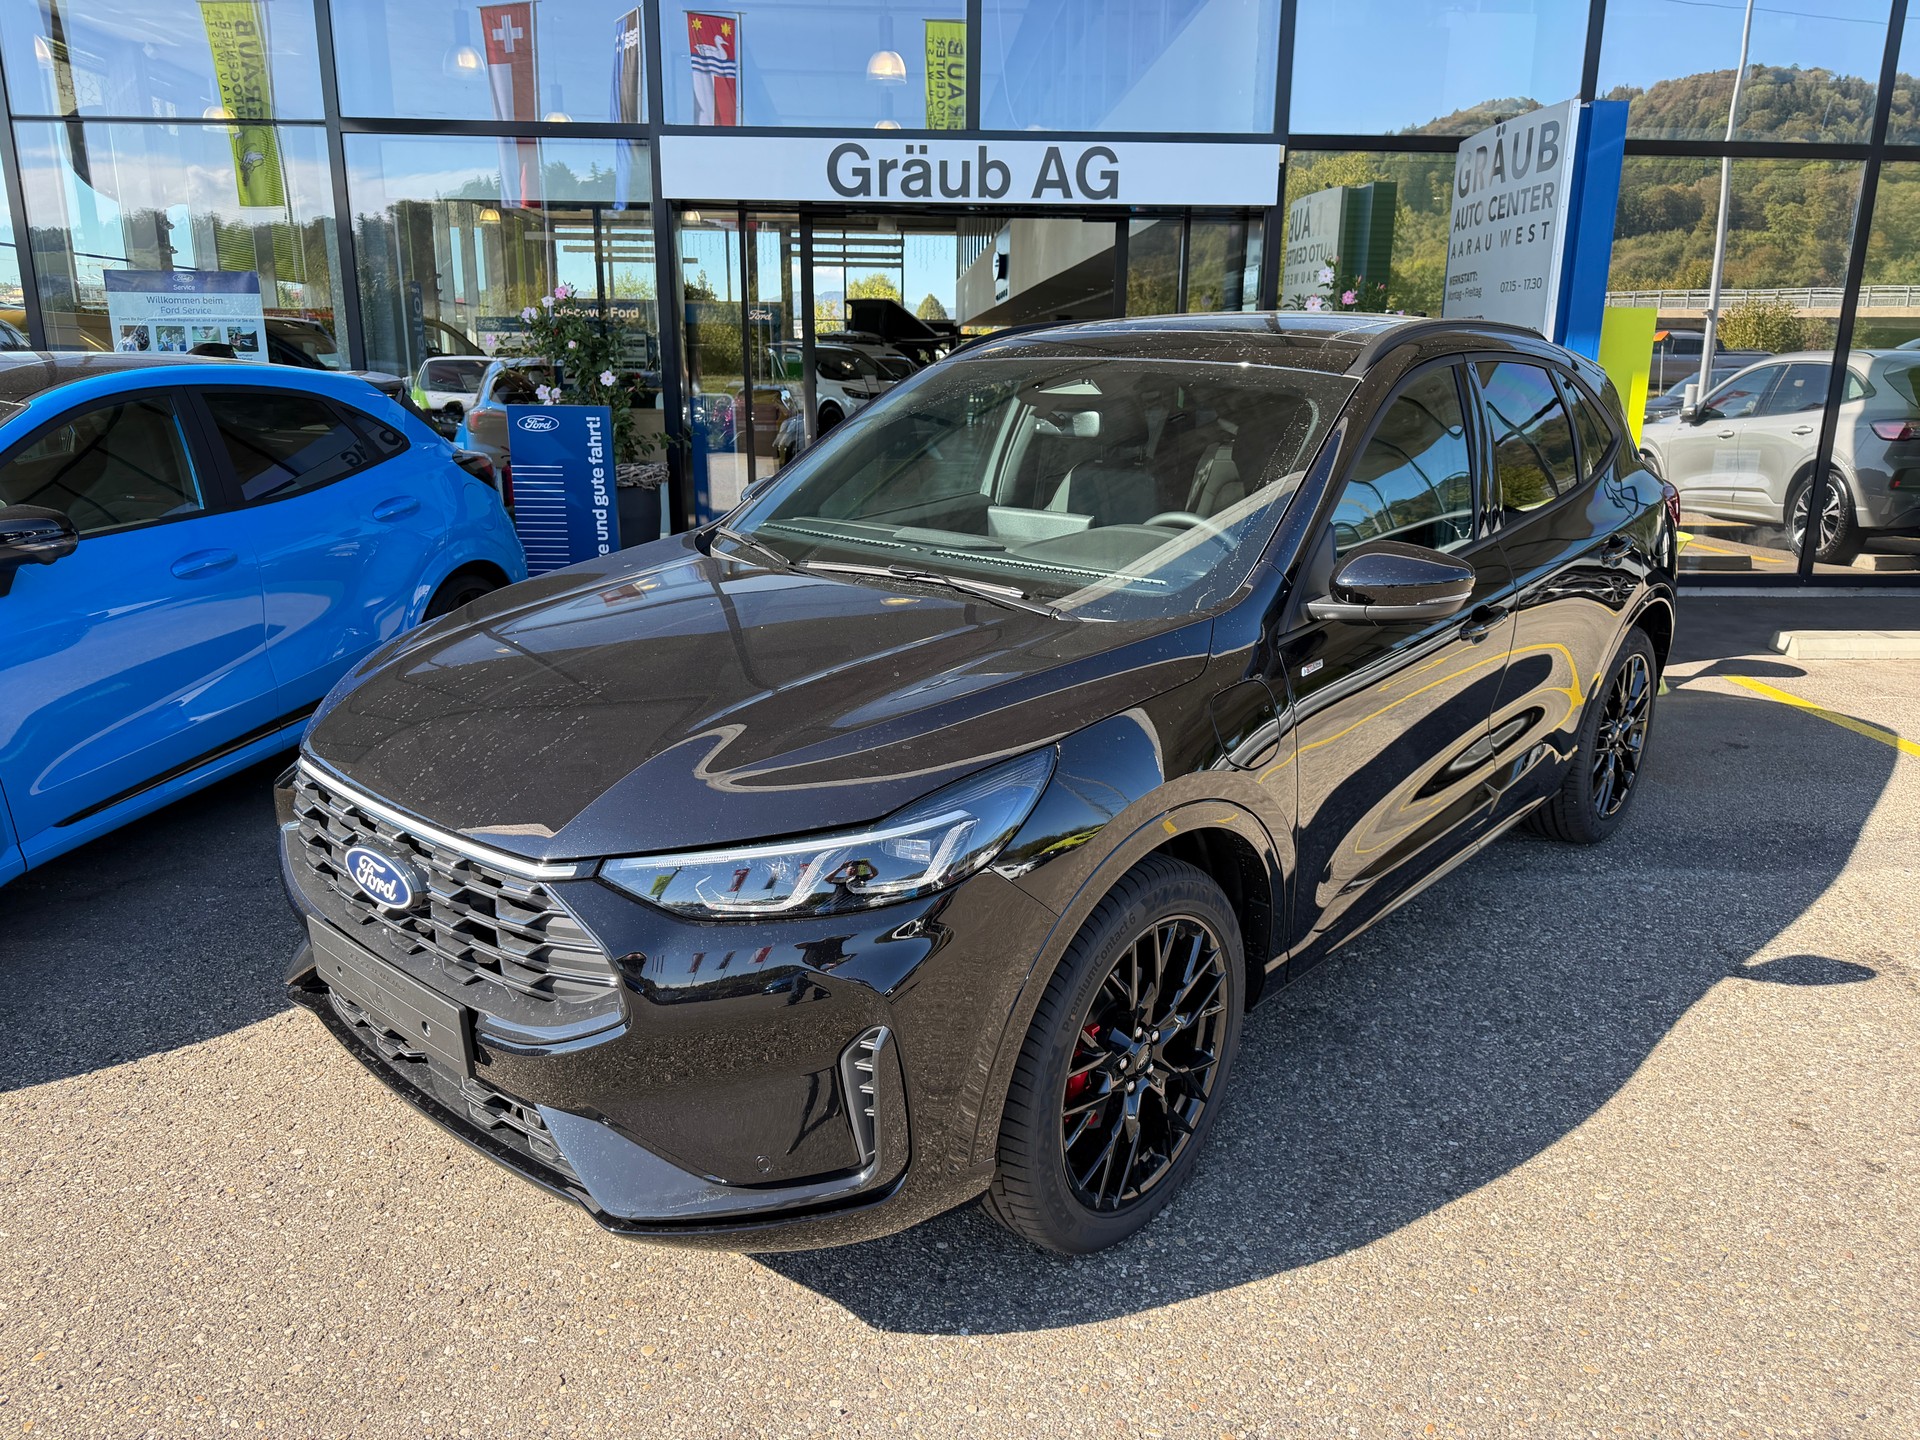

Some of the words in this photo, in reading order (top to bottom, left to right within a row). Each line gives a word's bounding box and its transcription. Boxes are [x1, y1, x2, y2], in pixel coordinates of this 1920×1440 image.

[827, 143, 1011, 198] Gräub
[1031, 146, 1119, 200] AG
[1458, 120, 1560, 198] GRÄUB
[1453, 200, 1484, 233] AUTO
[1488, 182, 1555, 222] CENTER
[1451, 233, 1492, 259] AARAU
[1500, 221, 1550, 248] WEST
[146, 296, 201, 304] Willkommen
[202, 296, 223, 304] beim
[160, 306, 180, 314] Ford
[610, 306, 639, 318] Ford
[749, 309, 773, 320] Ford
[521, 416, 555, 431] Ford
[583, 416, 604, 465] fahrt!
[591, 468, 610, 506] gute
[592, 509, 609, 541] und
[354, 853, 400, 903] Ford
[1062, 920, 1129, 1033] PremiumContact
[1129, 912, 1137, 926] 6
